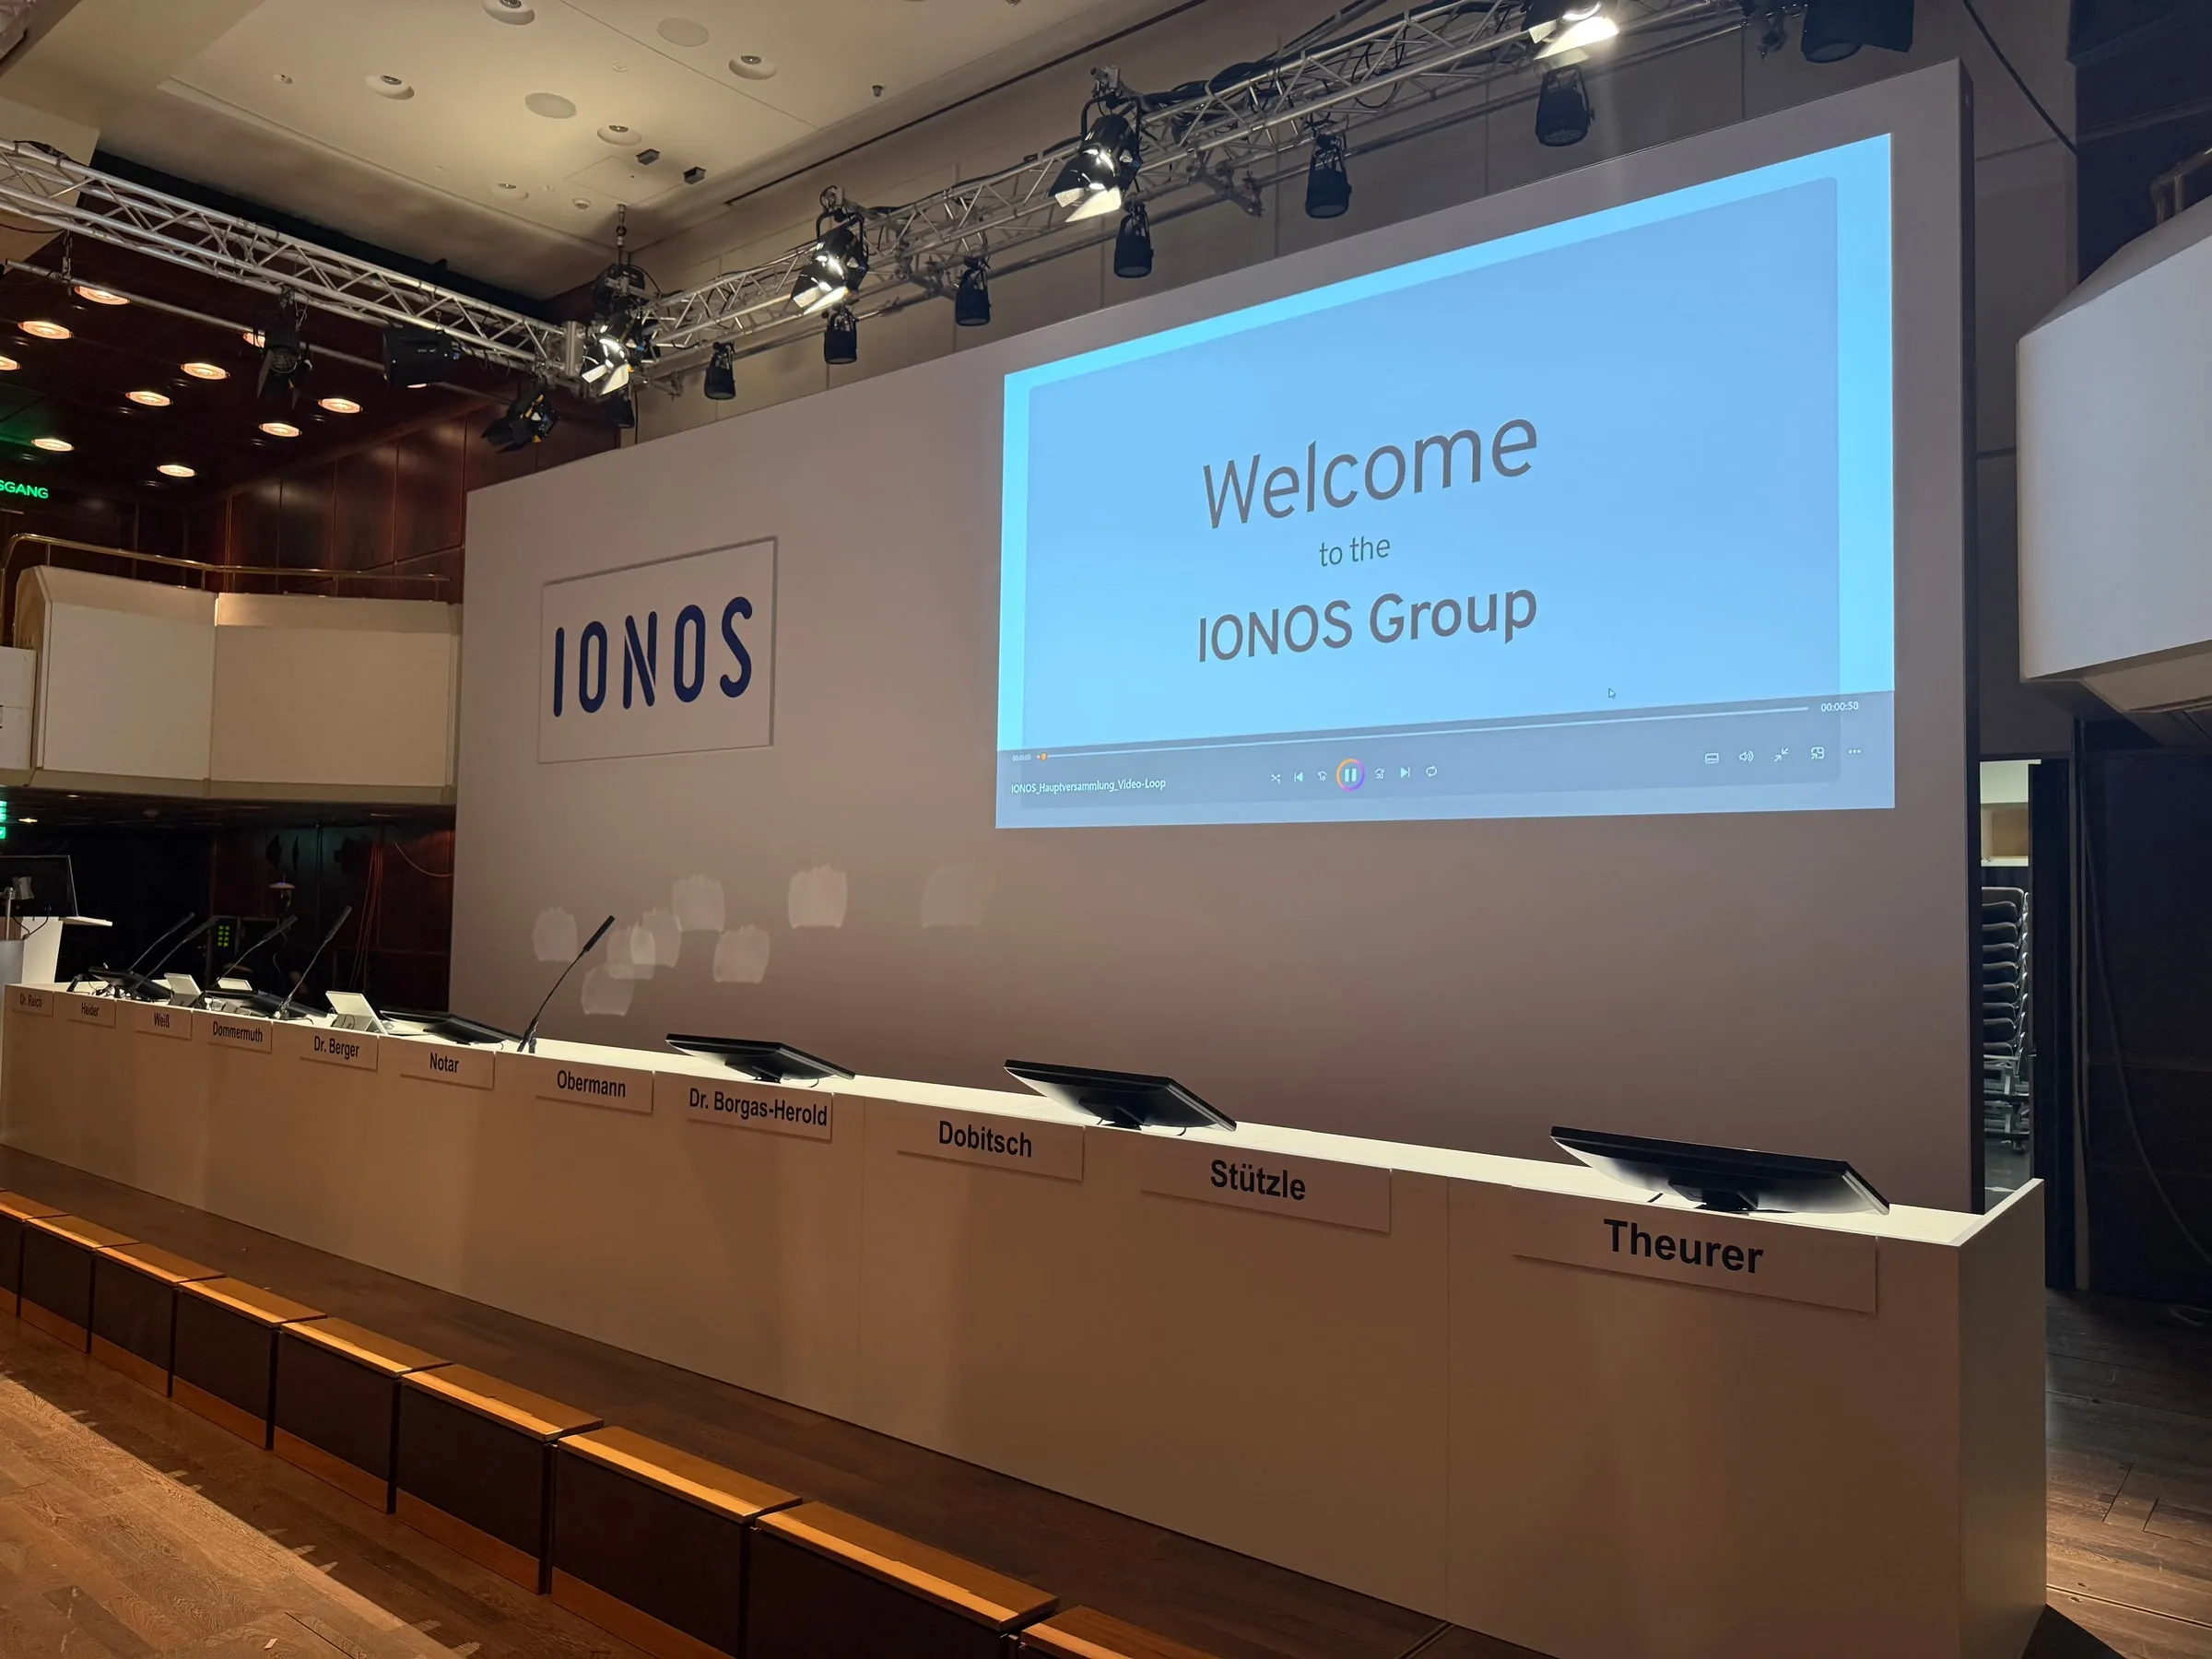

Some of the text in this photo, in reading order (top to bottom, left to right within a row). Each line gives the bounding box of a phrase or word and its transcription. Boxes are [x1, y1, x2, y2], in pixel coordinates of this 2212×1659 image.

[1203, 418, 1537, 529] Welcome
[1319, 535, 1391, 567] to the
[1199, 589, 1537, 662] IONOS Group
[553, 596, 753, 717] IONOS
[1011, 778, 1166, 794] IONOS_Hauptversammlung_Video-Loop
[153, 1013, 171, 1029] Weiß
[212, 1021, 264, 1042] Dommermuth
[313, 1035, 360, 1060] Dr. Berger
[429, 1053, 459, 1074] Notar
[557, 1070, 627, 1099] Obermann
[689, 1088, 829, 1127] Dr. Borgas-Herold
[939, 1121, 1032, 1158] Dobitsch
[1210, 1159, 1307, 1201] Stützle
[1604, 1218, 1764, 1274] Theurer
